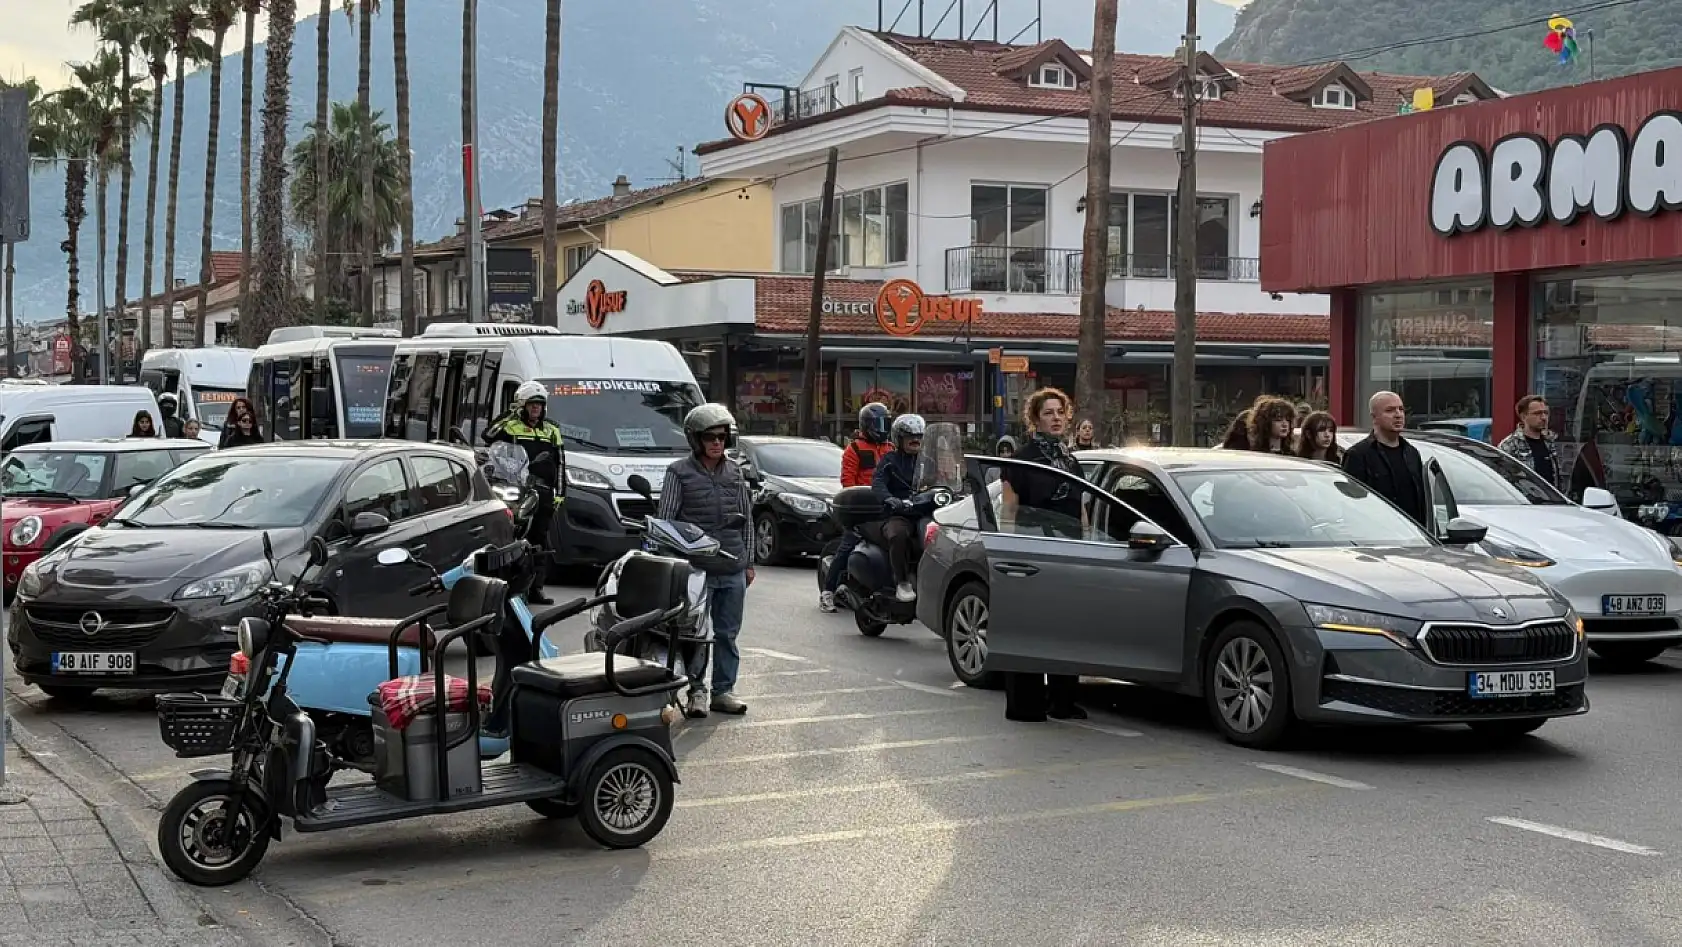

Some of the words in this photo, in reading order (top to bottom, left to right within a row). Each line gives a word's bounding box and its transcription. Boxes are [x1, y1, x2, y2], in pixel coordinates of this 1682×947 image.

[734, 100, 764, 137] Y
[1430, 111, 1682, 236] ARMA
[822, 295, 875, 314] ÖFTECİ
[578, 379, 662, 392] SEYDİKEMER
[1611, 597, 1622, 610] 48
[1647, 597, 1664, 610] 039
[60, 654, 76, 669] 48
[80, 654, 100, 669] AIF
[107, 654, 133, 669] 908
[1478, 674, 1494, 691] 34
[1500, 673, 1524, 691] MDU
[1529, 671, 1552, 689] 935
